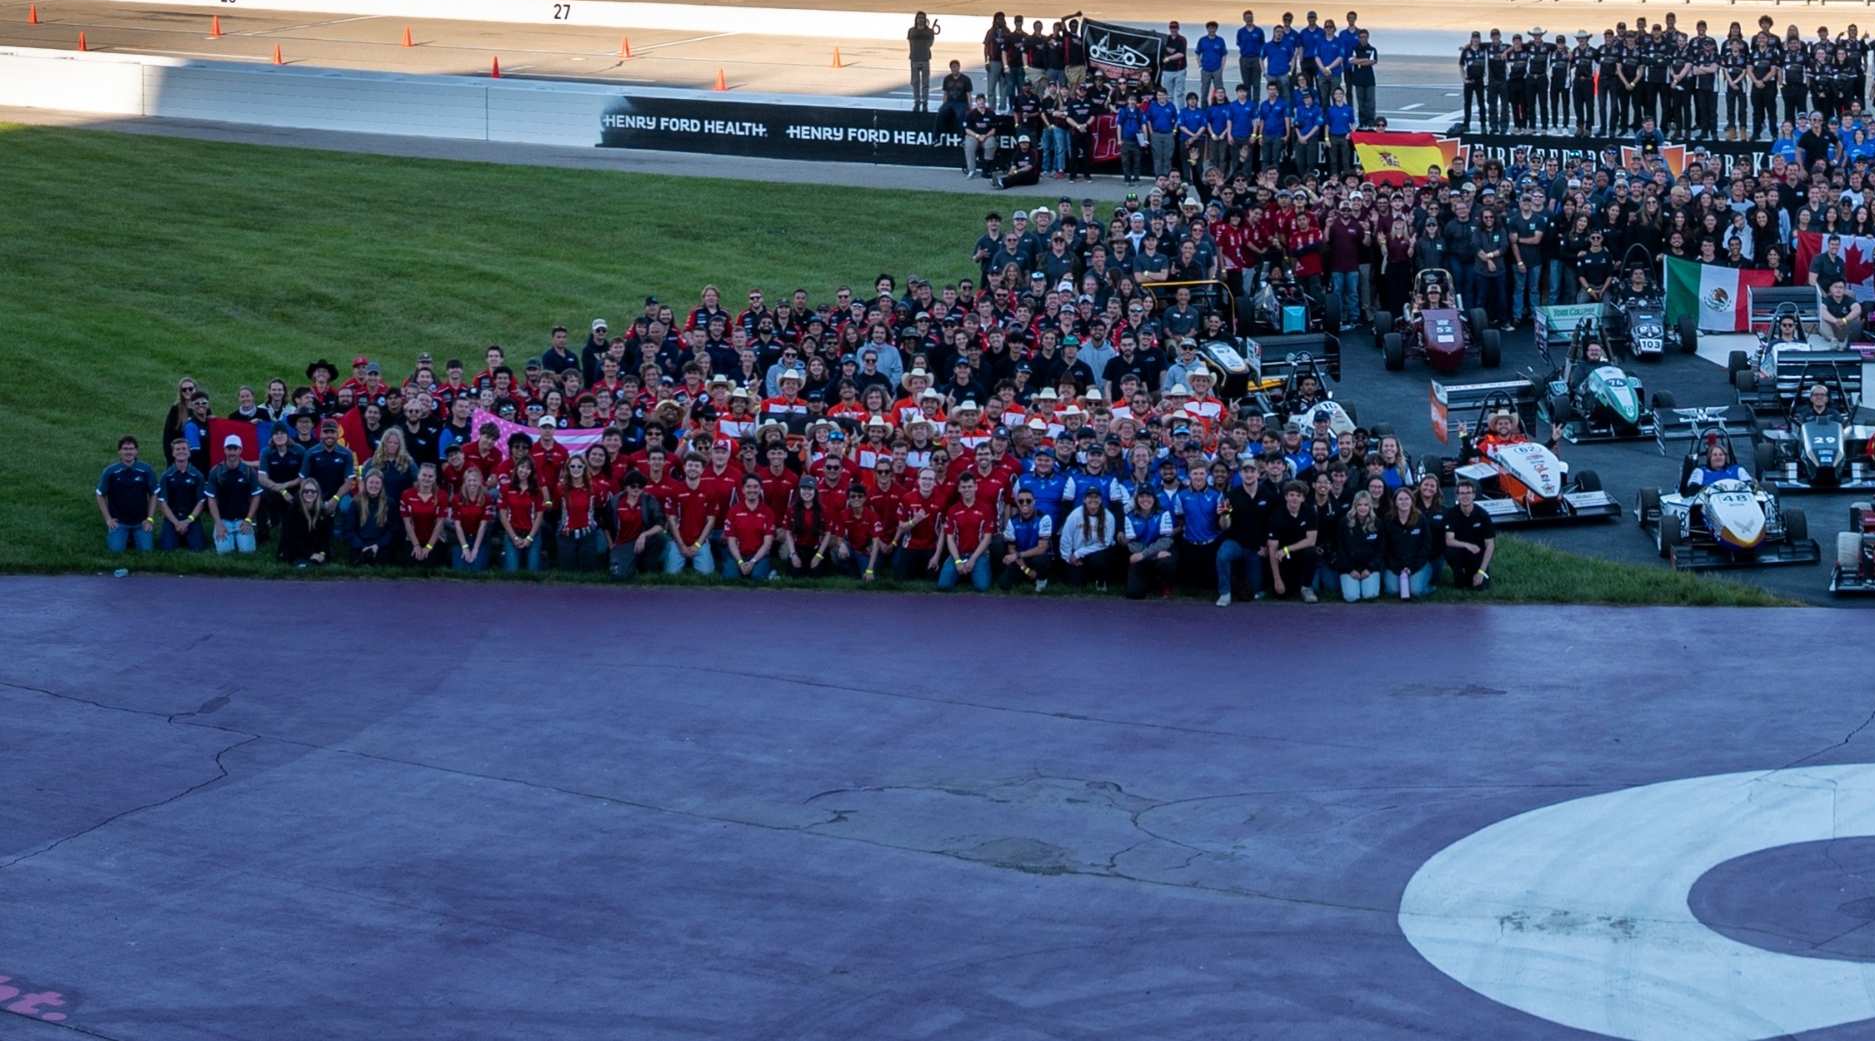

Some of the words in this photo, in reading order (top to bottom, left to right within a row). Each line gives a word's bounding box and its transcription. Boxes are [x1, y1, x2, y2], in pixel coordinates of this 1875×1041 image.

[553, 4, 571, 20] 27
[603, 114, 657, 130] HENRY
[660, 116, 700, 132] FORD
[704, 120, 767, 137] HEALTH
[786, 125, 844, 141] HENRY
[848, 128, 890, 144] FORD
[1641, 340, 1661, 349] 103
